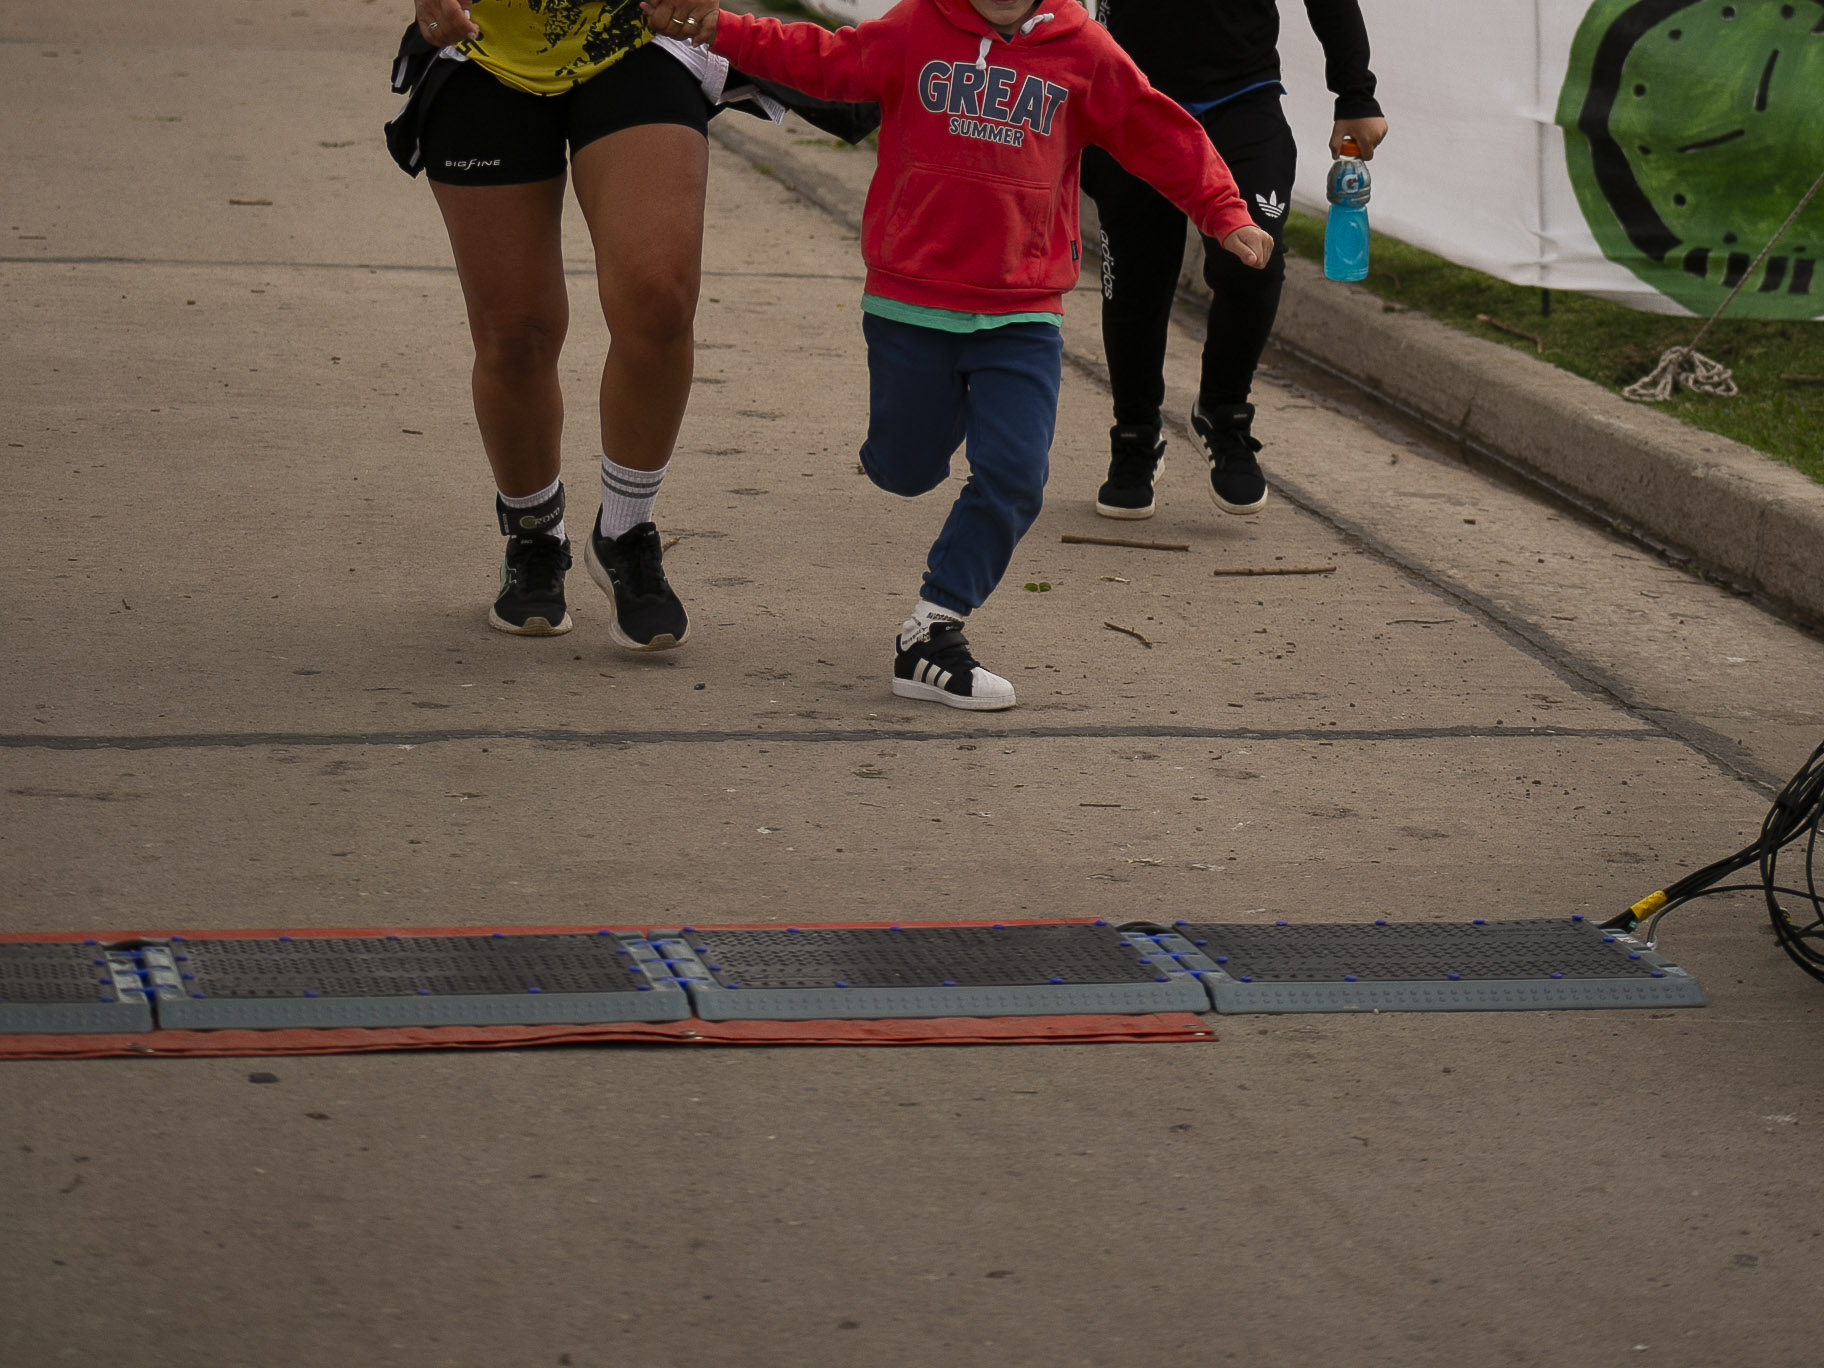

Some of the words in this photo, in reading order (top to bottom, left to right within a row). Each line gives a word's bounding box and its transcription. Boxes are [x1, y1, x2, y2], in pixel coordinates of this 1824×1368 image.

[918, 60, 1069, 136] GREAT
[949, 117, 1025, 148] SUMMER
[1100, 229, 1116, 300] adidas
